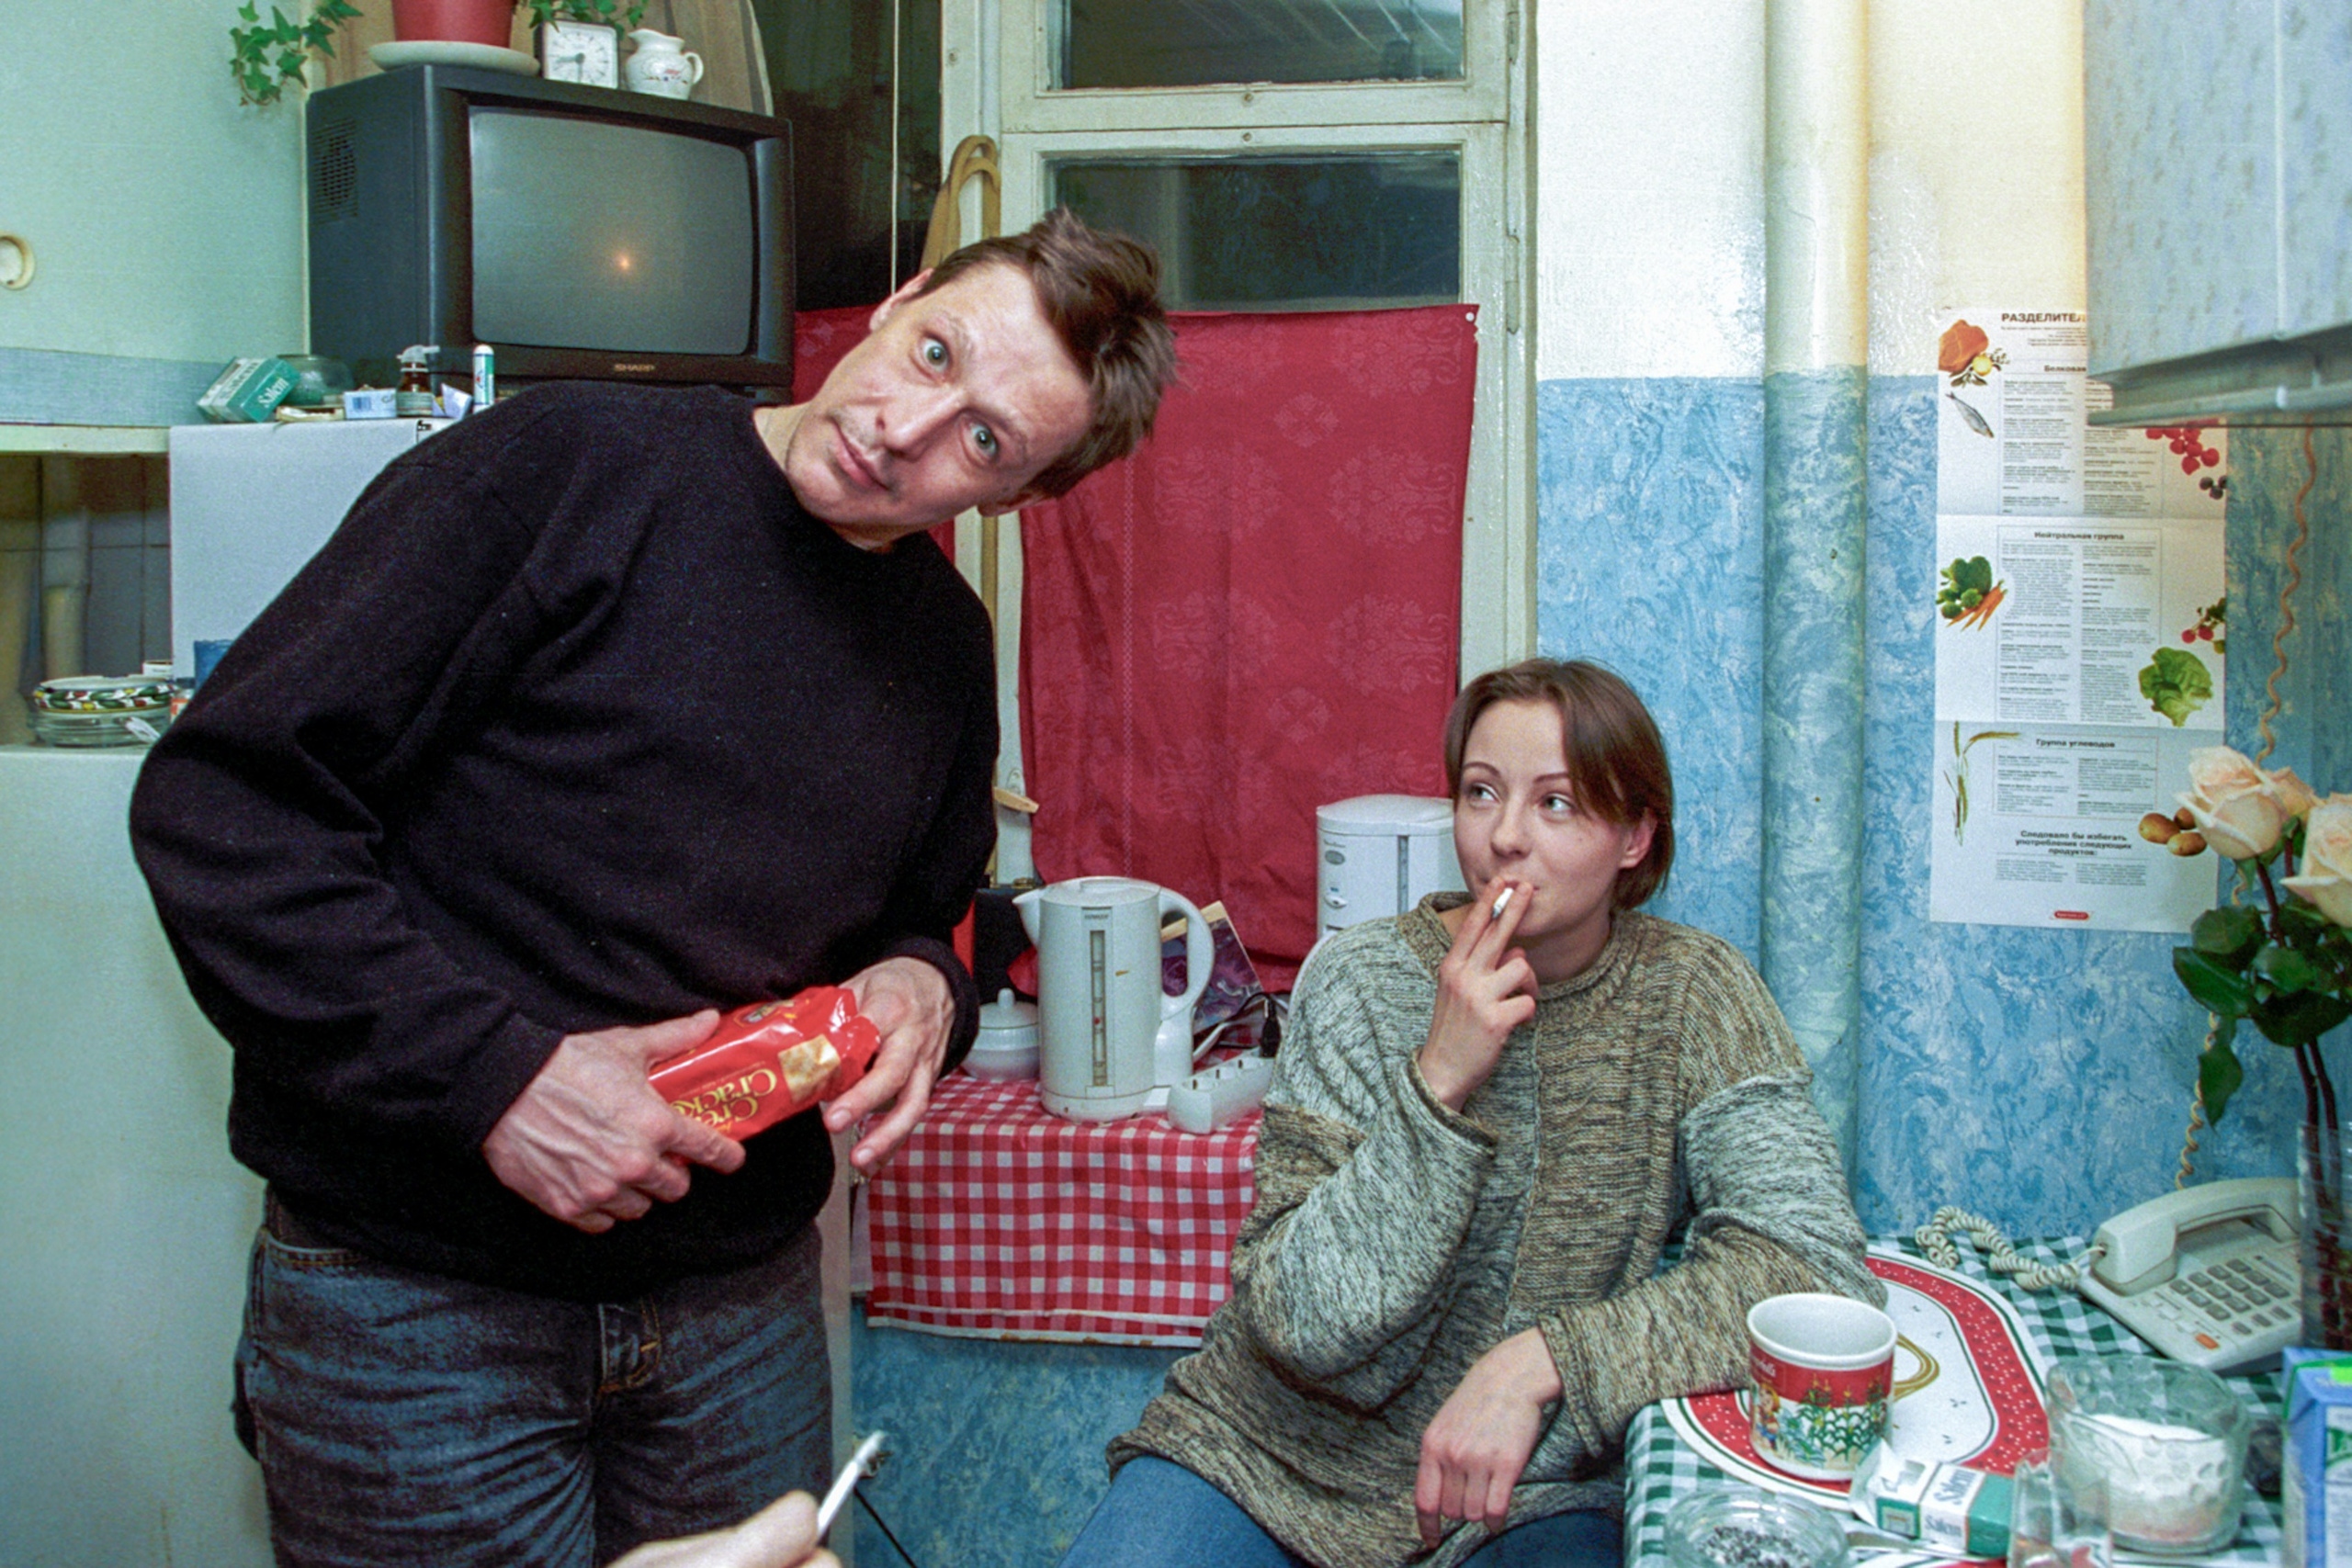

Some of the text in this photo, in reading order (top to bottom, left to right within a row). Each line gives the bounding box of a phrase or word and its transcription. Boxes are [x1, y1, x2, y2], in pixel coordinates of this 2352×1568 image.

[2001, 312, 2086, 323] РАЗДЕЛИТЕЛ
[258, 377, 289, 408] Salem
[2034, 531, 2092, 539] Нейтральная
[2036, 739, 2066, 747] Группа
[2020, 829, 2069, 838] Следовало
[2015, 838, 2077, 846] употребления
[695, 1097, 758, 1127] Cre
[1933, 1469, 1976, 1506] Salem
[1925, 1515, 1962, 1538] Salem
